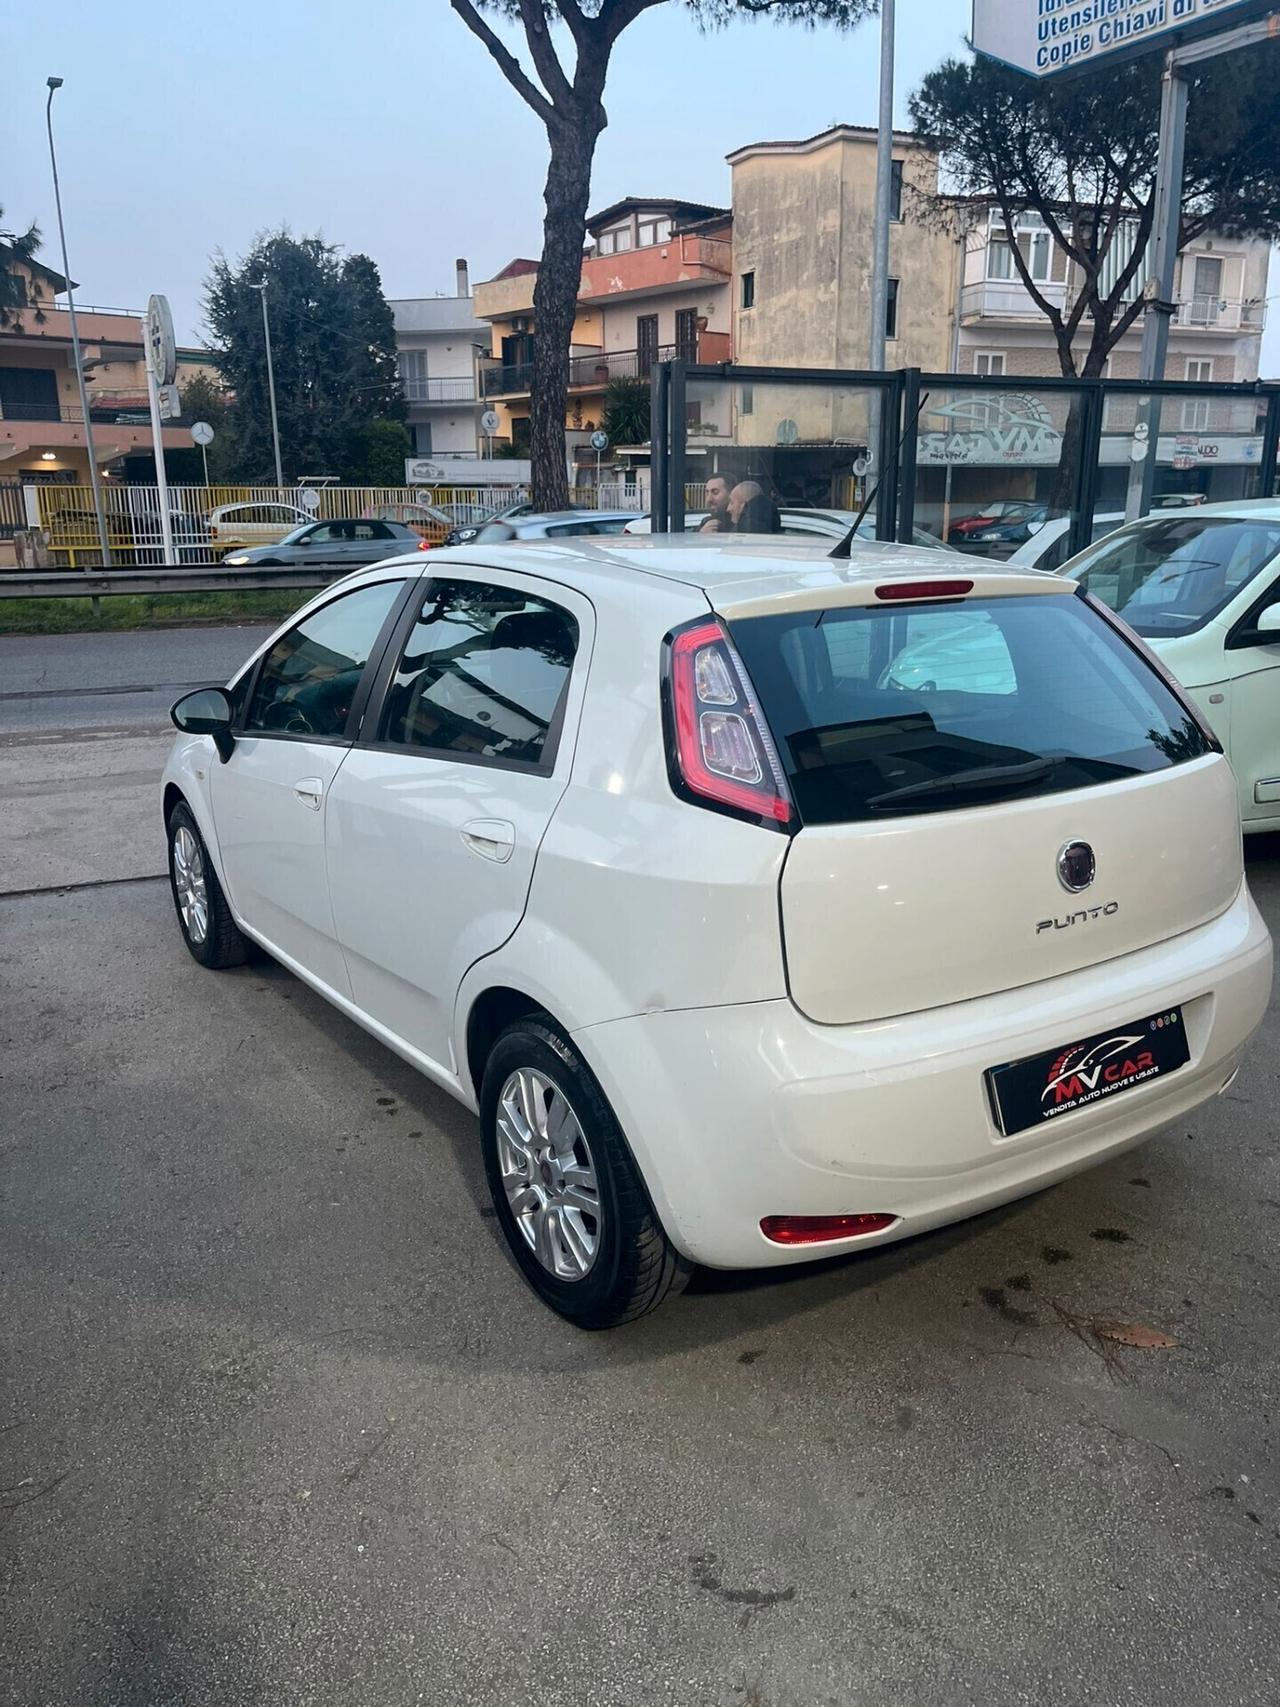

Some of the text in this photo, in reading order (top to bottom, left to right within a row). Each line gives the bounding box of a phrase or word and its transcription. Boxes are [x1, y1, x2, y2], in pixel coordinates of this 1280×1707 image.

[1037, 34, 1090, 67] Copie
[1099, 0, 1164, 44] Chiavi
[1038, 0, 1147, 42] Utensile
[1035, 901, 1119, 935] PUNTO
[1043, 1065, 1160, 1118] VENDITA AUTO NUOVE E USATE
